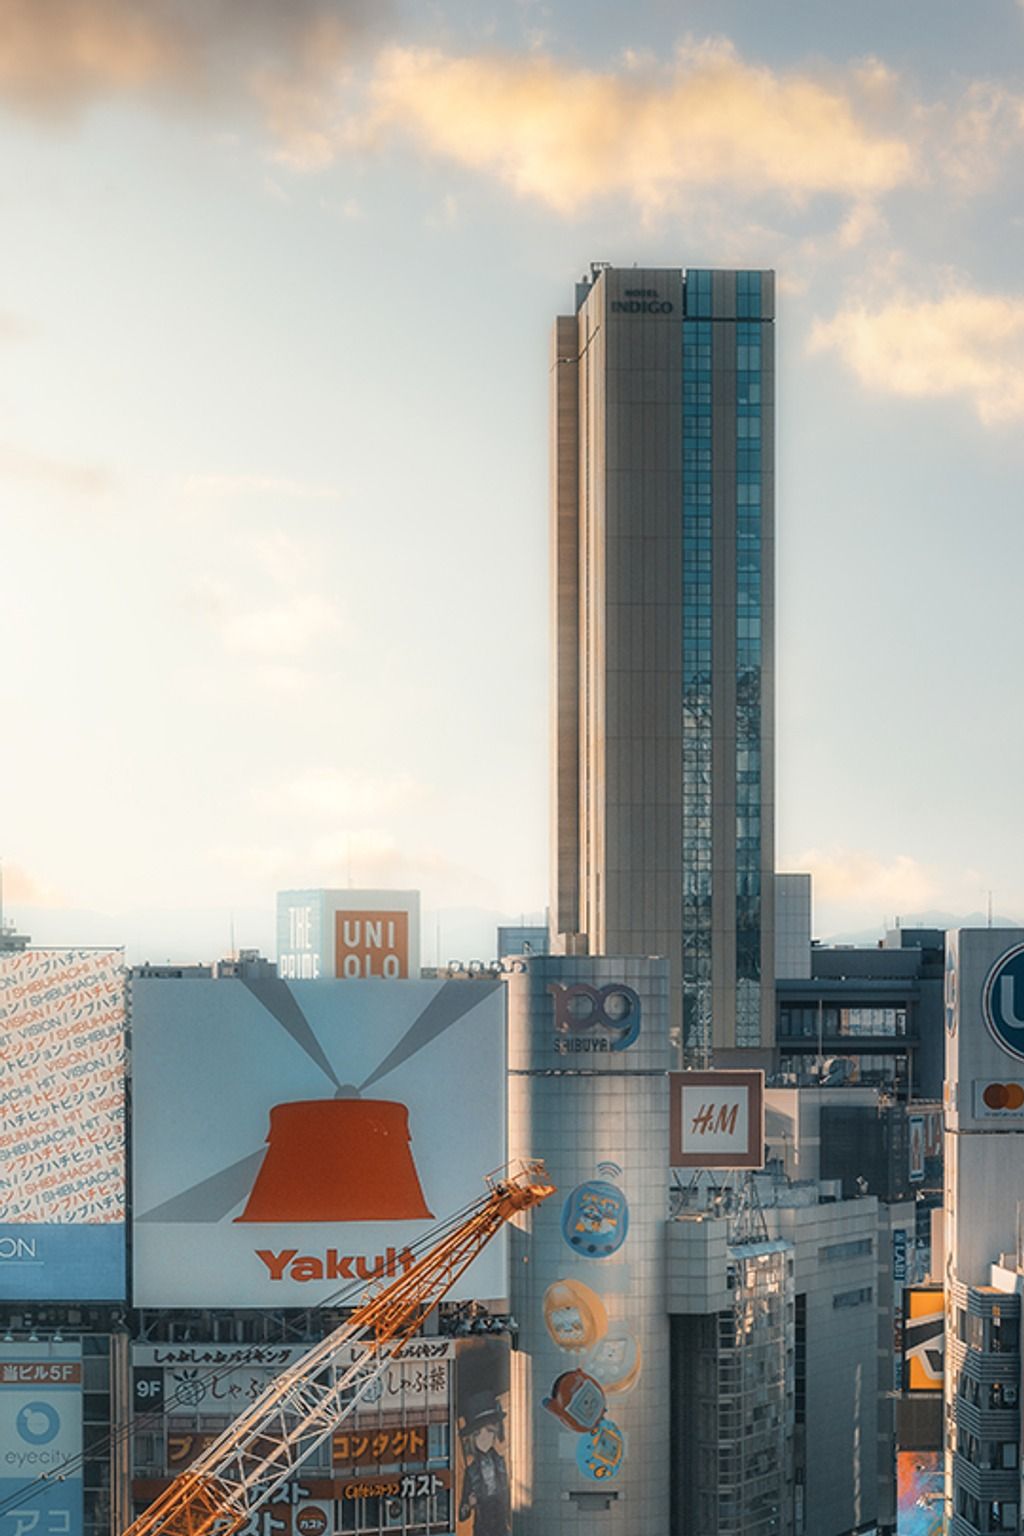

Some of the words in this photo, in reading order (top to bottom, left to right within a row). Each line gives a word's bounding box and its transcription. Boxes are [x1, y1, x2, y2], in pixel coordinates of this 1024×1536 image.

[611, 301, 674, 314] INDIGO
[343, 920, 395, 948] UNI
[548, 982, 642, 1051] 109
[553, 1037, 609, 1053] SHIBUYA
[692, 1103, 739, 1135] H&M
[254, 1247, 416, 1282] Yakult
[3, 1365, 74, 1381] 当ビル5F
[136, 1380, 161, 1398] 9F
[333, 1429, 425, 1460] コンタクト
[4, 1451, 72, 1471] eyecity
[401, 1474, 444, 1499] ガスト
